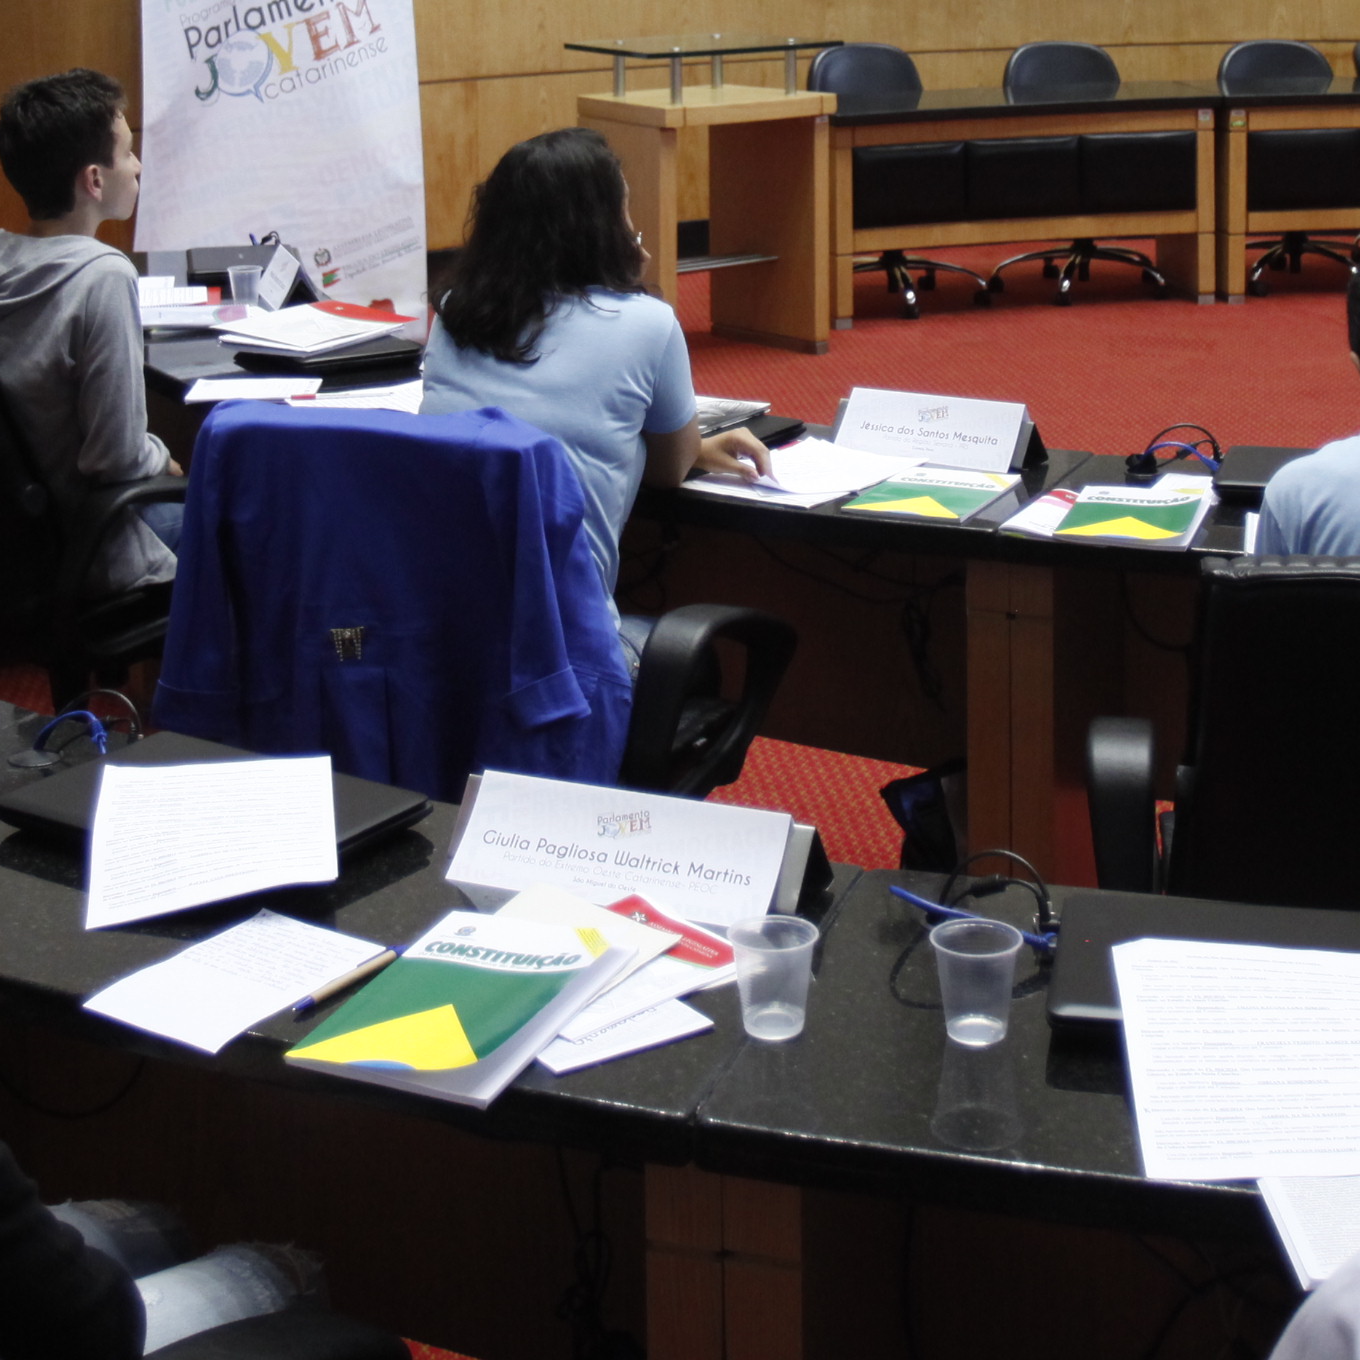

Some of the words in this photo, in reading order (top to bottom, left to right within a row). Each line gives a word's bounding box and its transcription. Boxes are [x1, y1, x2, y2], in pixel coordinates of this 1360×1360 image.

[264, 36, 388, 100] catarinense
[860, 420, 894, 434] Jéssica
[897, 425, 914, 436] dos
[917, 427, 949, 440] Santos
[953, 431, 998, 447] Mesquita
[900, 477, 996, 490] CONSTITUIÇÃO
[1087, 494, 1192, 506] CONSTITUIÇÃO
[597, 810, 651, 825] Parlamento
[482, 828, 531, 851] Giulia
[535, 837, 609, 865] Pagliosa
[614, 850, 681, 876] Waltrick
[687, 861, 752, 887] Martins
[503, 850, 536, 865] Partido
[554, 859, 590, 875] Extremo
[592, 865, 623, 879] Oeste
[585, 878, 609, 891] Miguel
[618, 883, 637, 893] Oeste
[424, 939, 583, 970] CONSTITUIÇÃO
